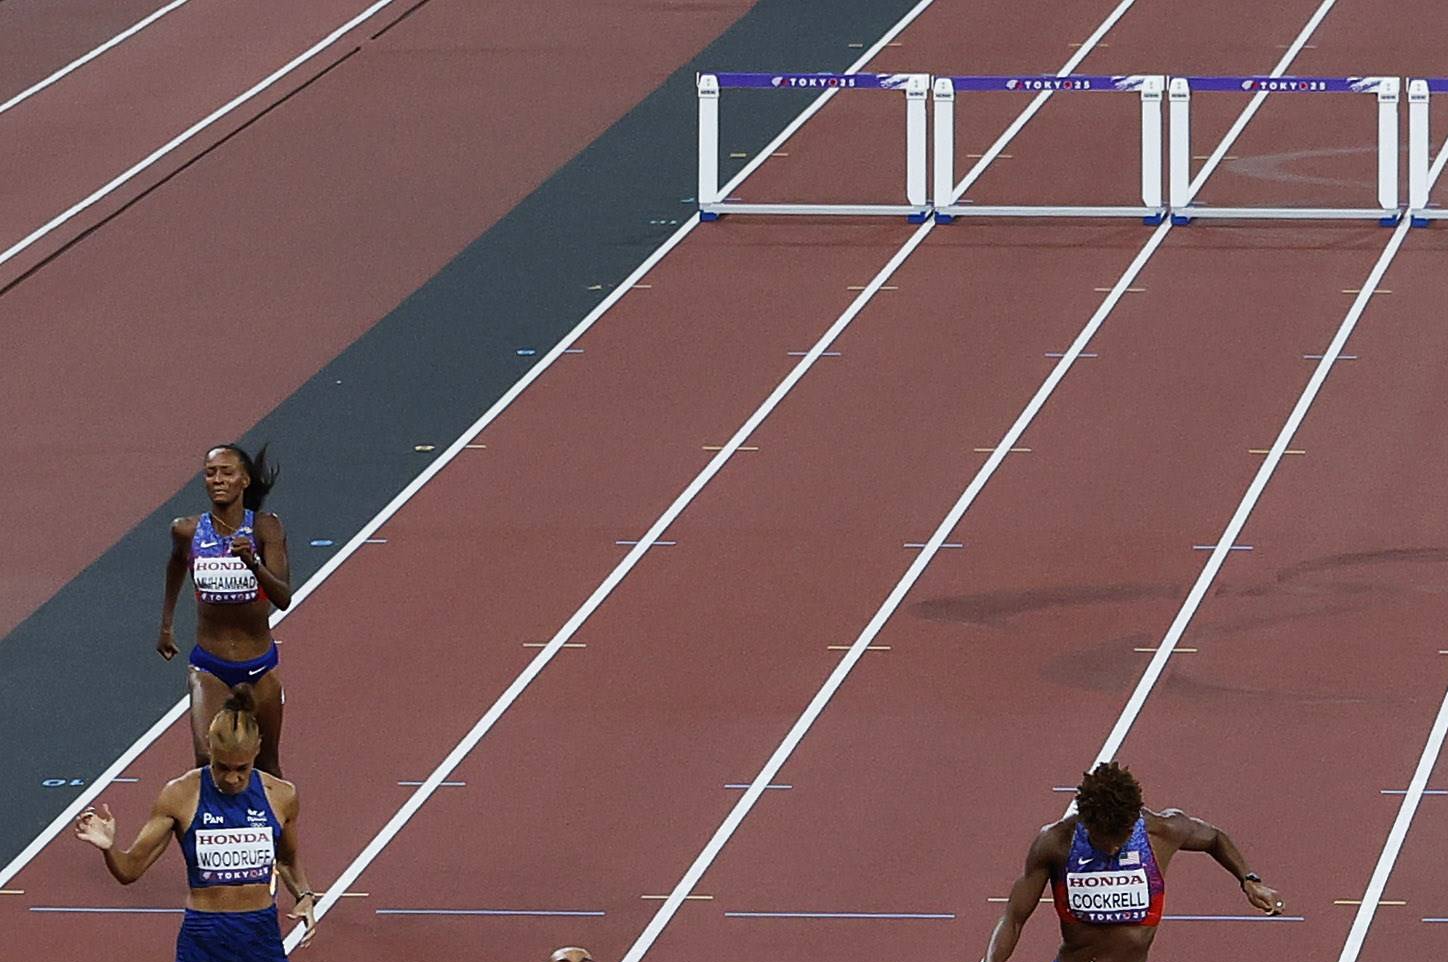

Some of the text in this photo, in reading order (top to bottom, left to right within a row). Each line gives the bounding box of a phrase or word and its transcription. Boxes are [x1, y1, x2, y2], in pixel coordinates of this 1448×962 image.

[196, 562, 248, 571] HOND
[199, 833, 270, 845] HONDA
[200, 849, 271, 867] WOODRUFF
[1069, 875, 1145, 888] HONDA
[1072, 891, 1146, 909] COCKRELL
